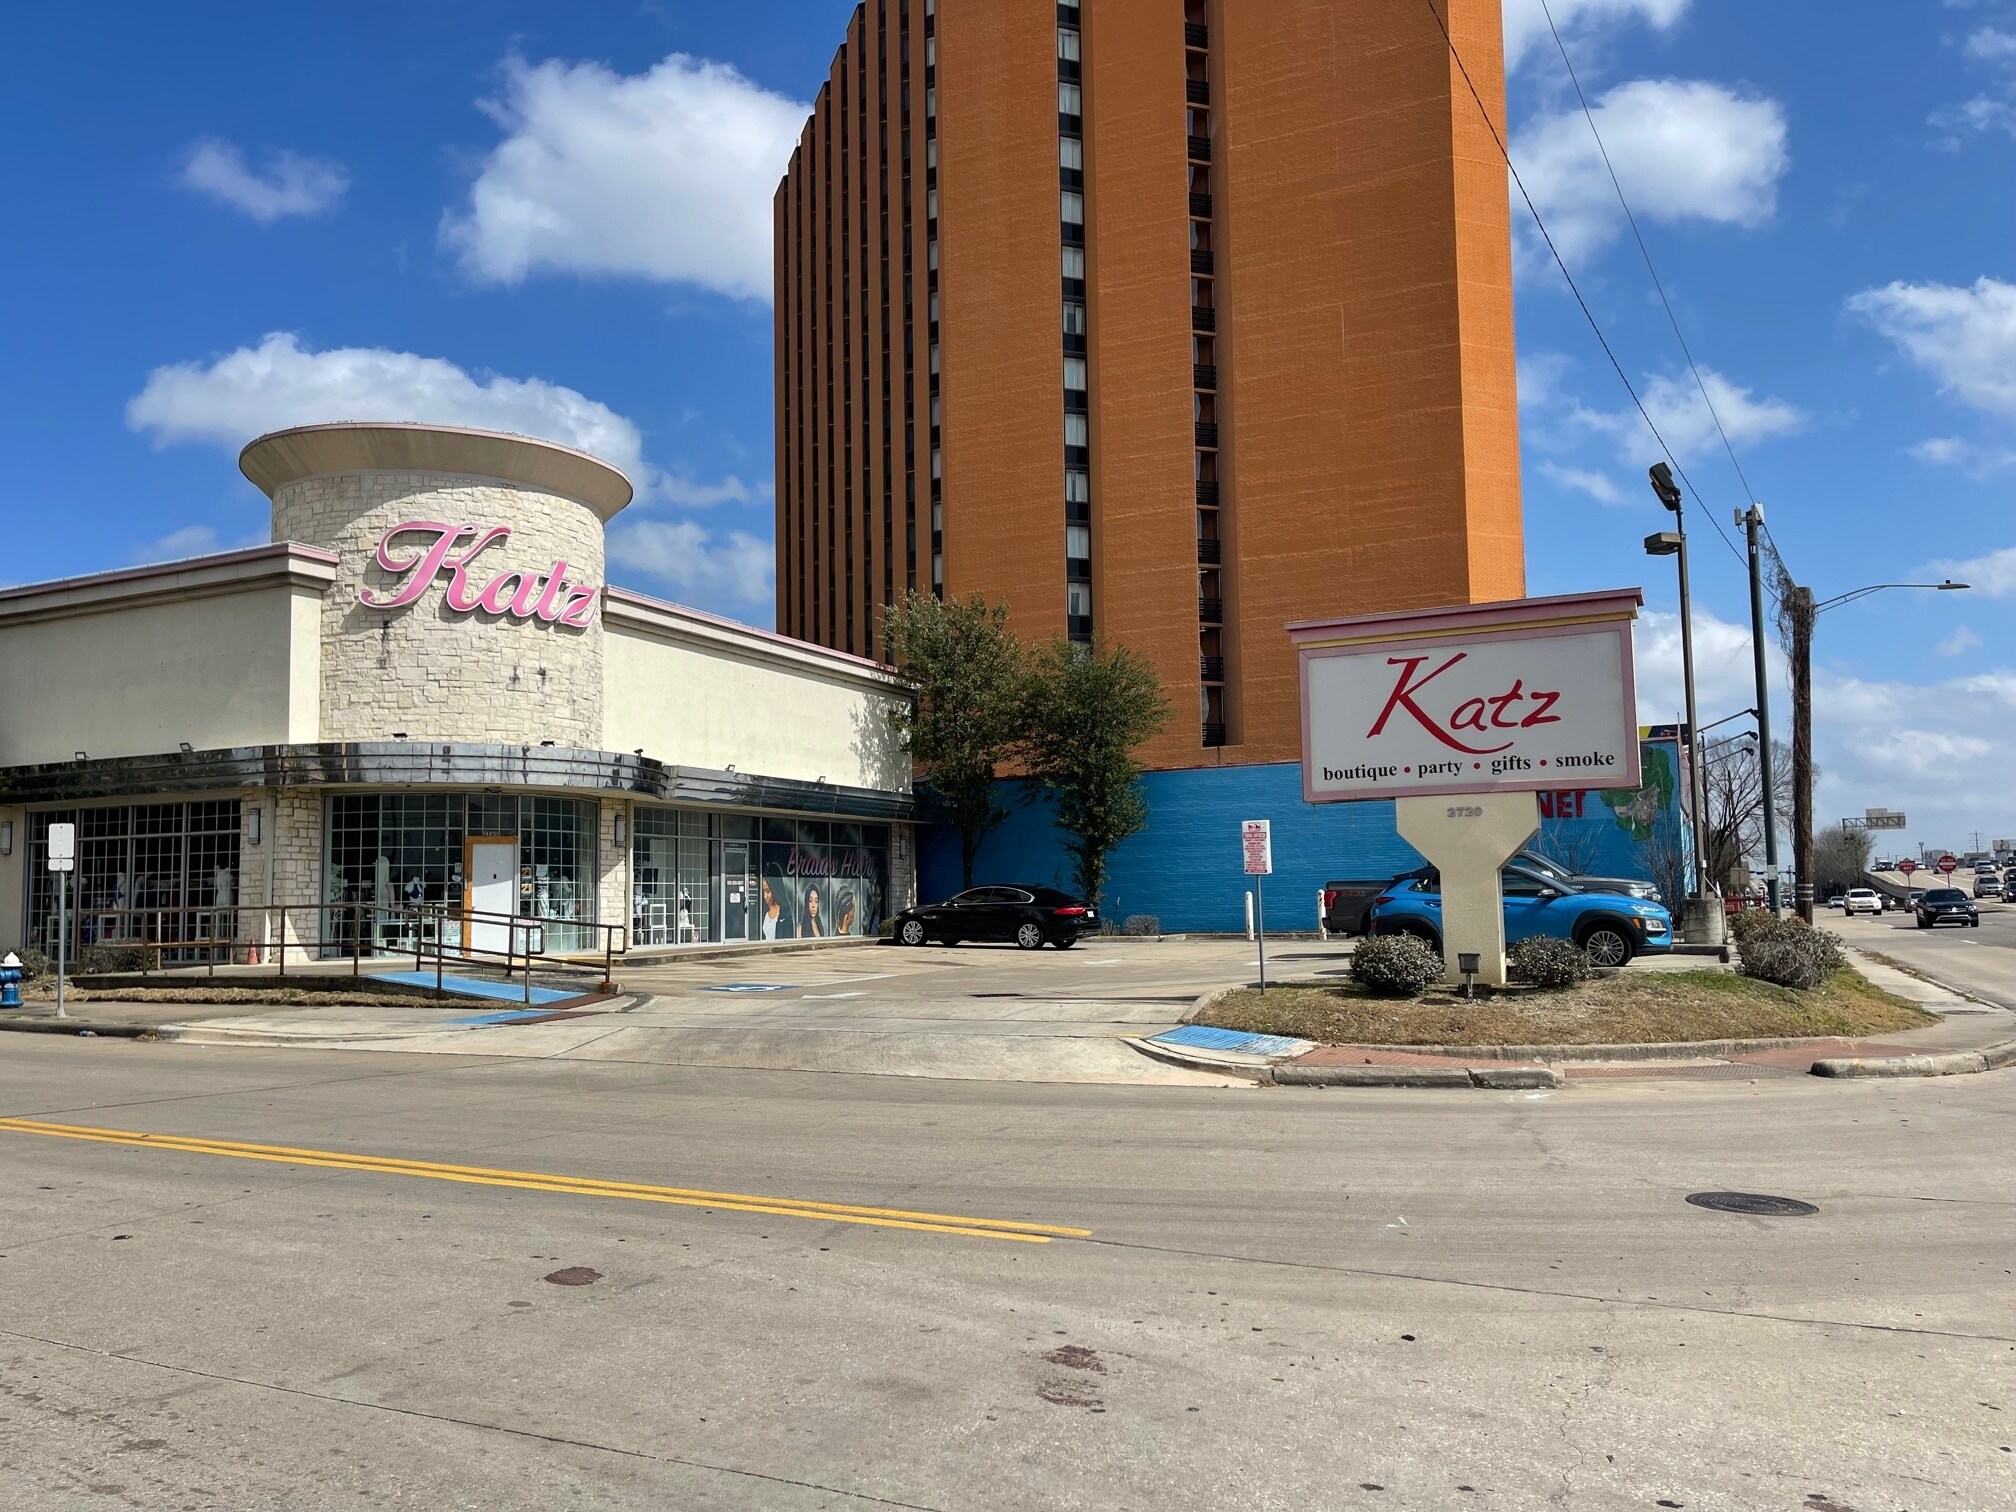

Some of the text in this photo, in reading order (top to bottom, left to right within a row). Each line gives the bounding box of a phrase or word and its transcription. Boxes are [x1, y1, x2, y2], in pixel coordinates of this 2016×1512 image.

[358, 520, 597, 628] Katz
[1366, 652, 1562, 755] Katz
[1322, 750, 1615, 783] boutique party gifts smoke
[1447, 806, 1483, 818] 2720
